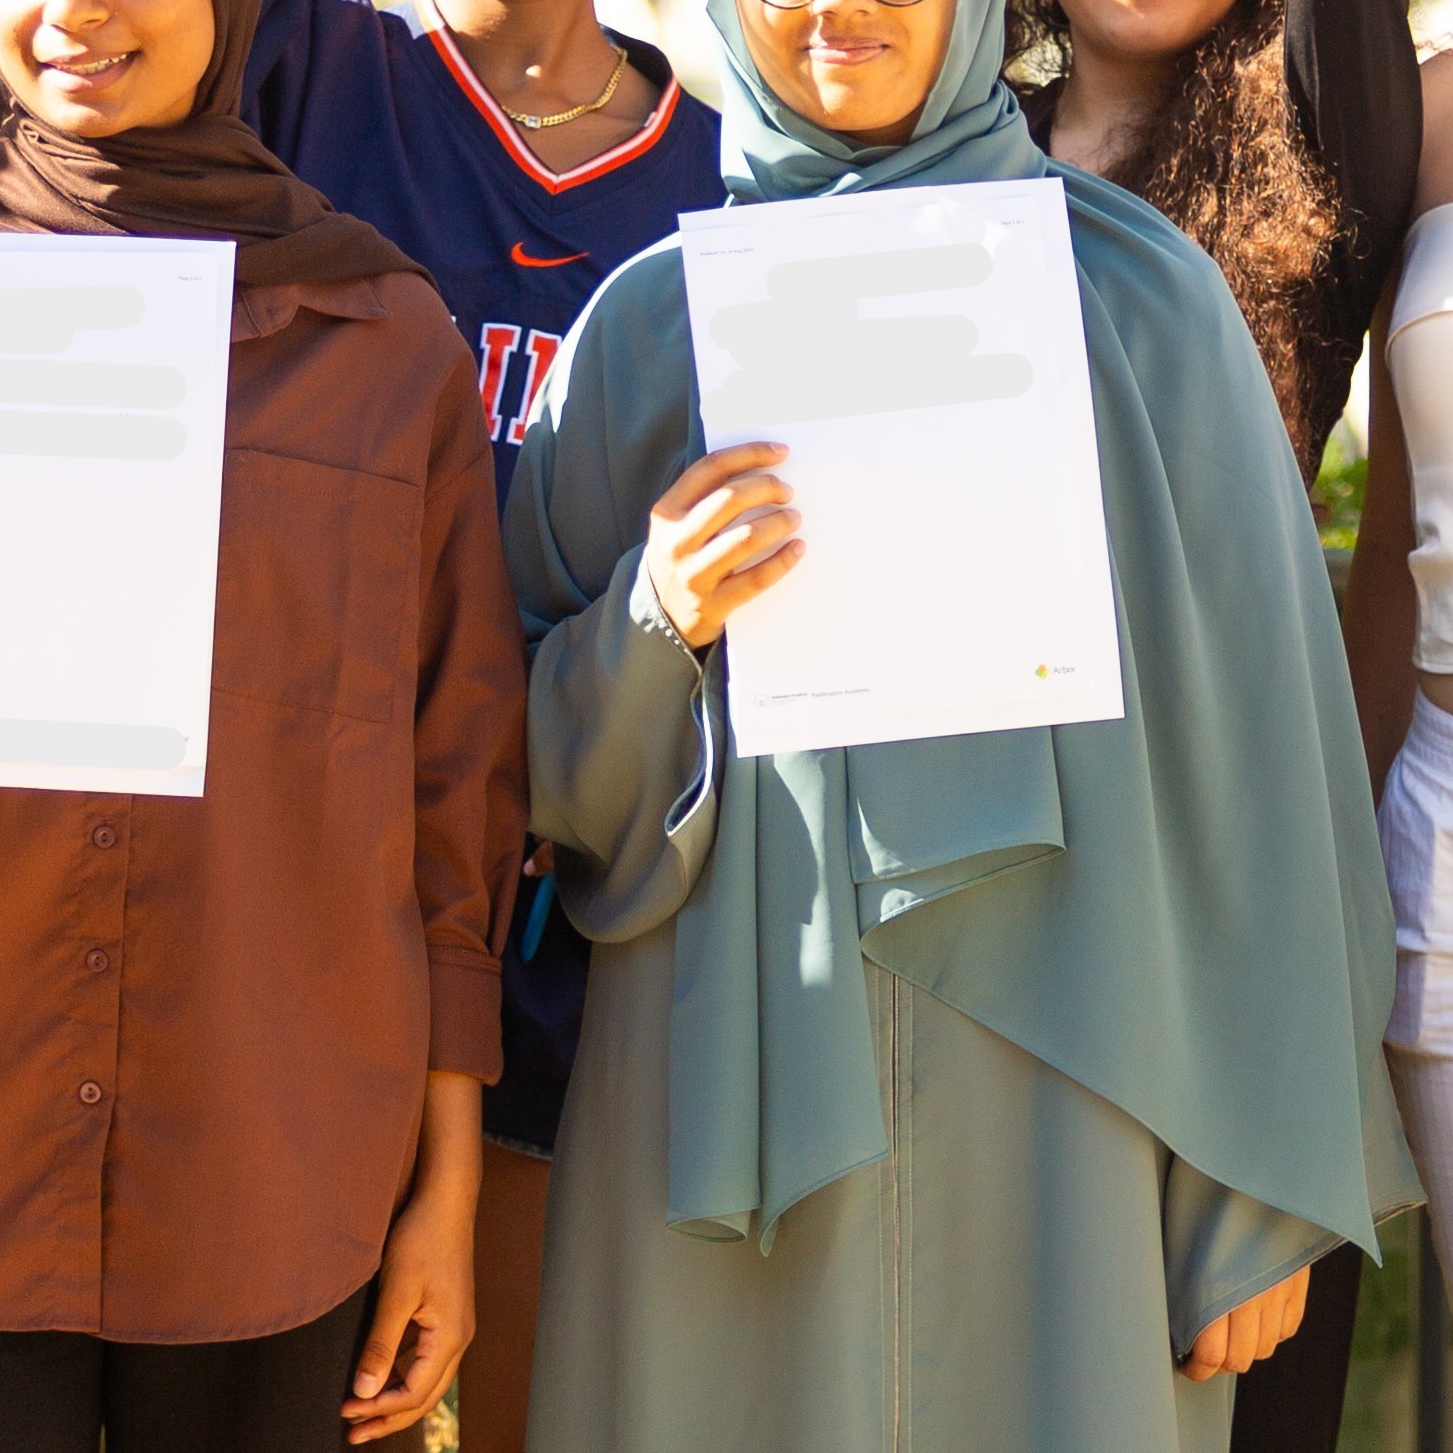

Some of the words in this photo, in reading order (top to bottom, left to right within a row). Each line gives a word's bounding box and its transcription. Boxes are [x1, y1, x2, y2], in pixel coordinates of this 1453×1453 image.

[1052, 665, 1076, 675] Arbor
[811, 690, 843, 699] Paddington
[844, 688, 869, 696] Academy
